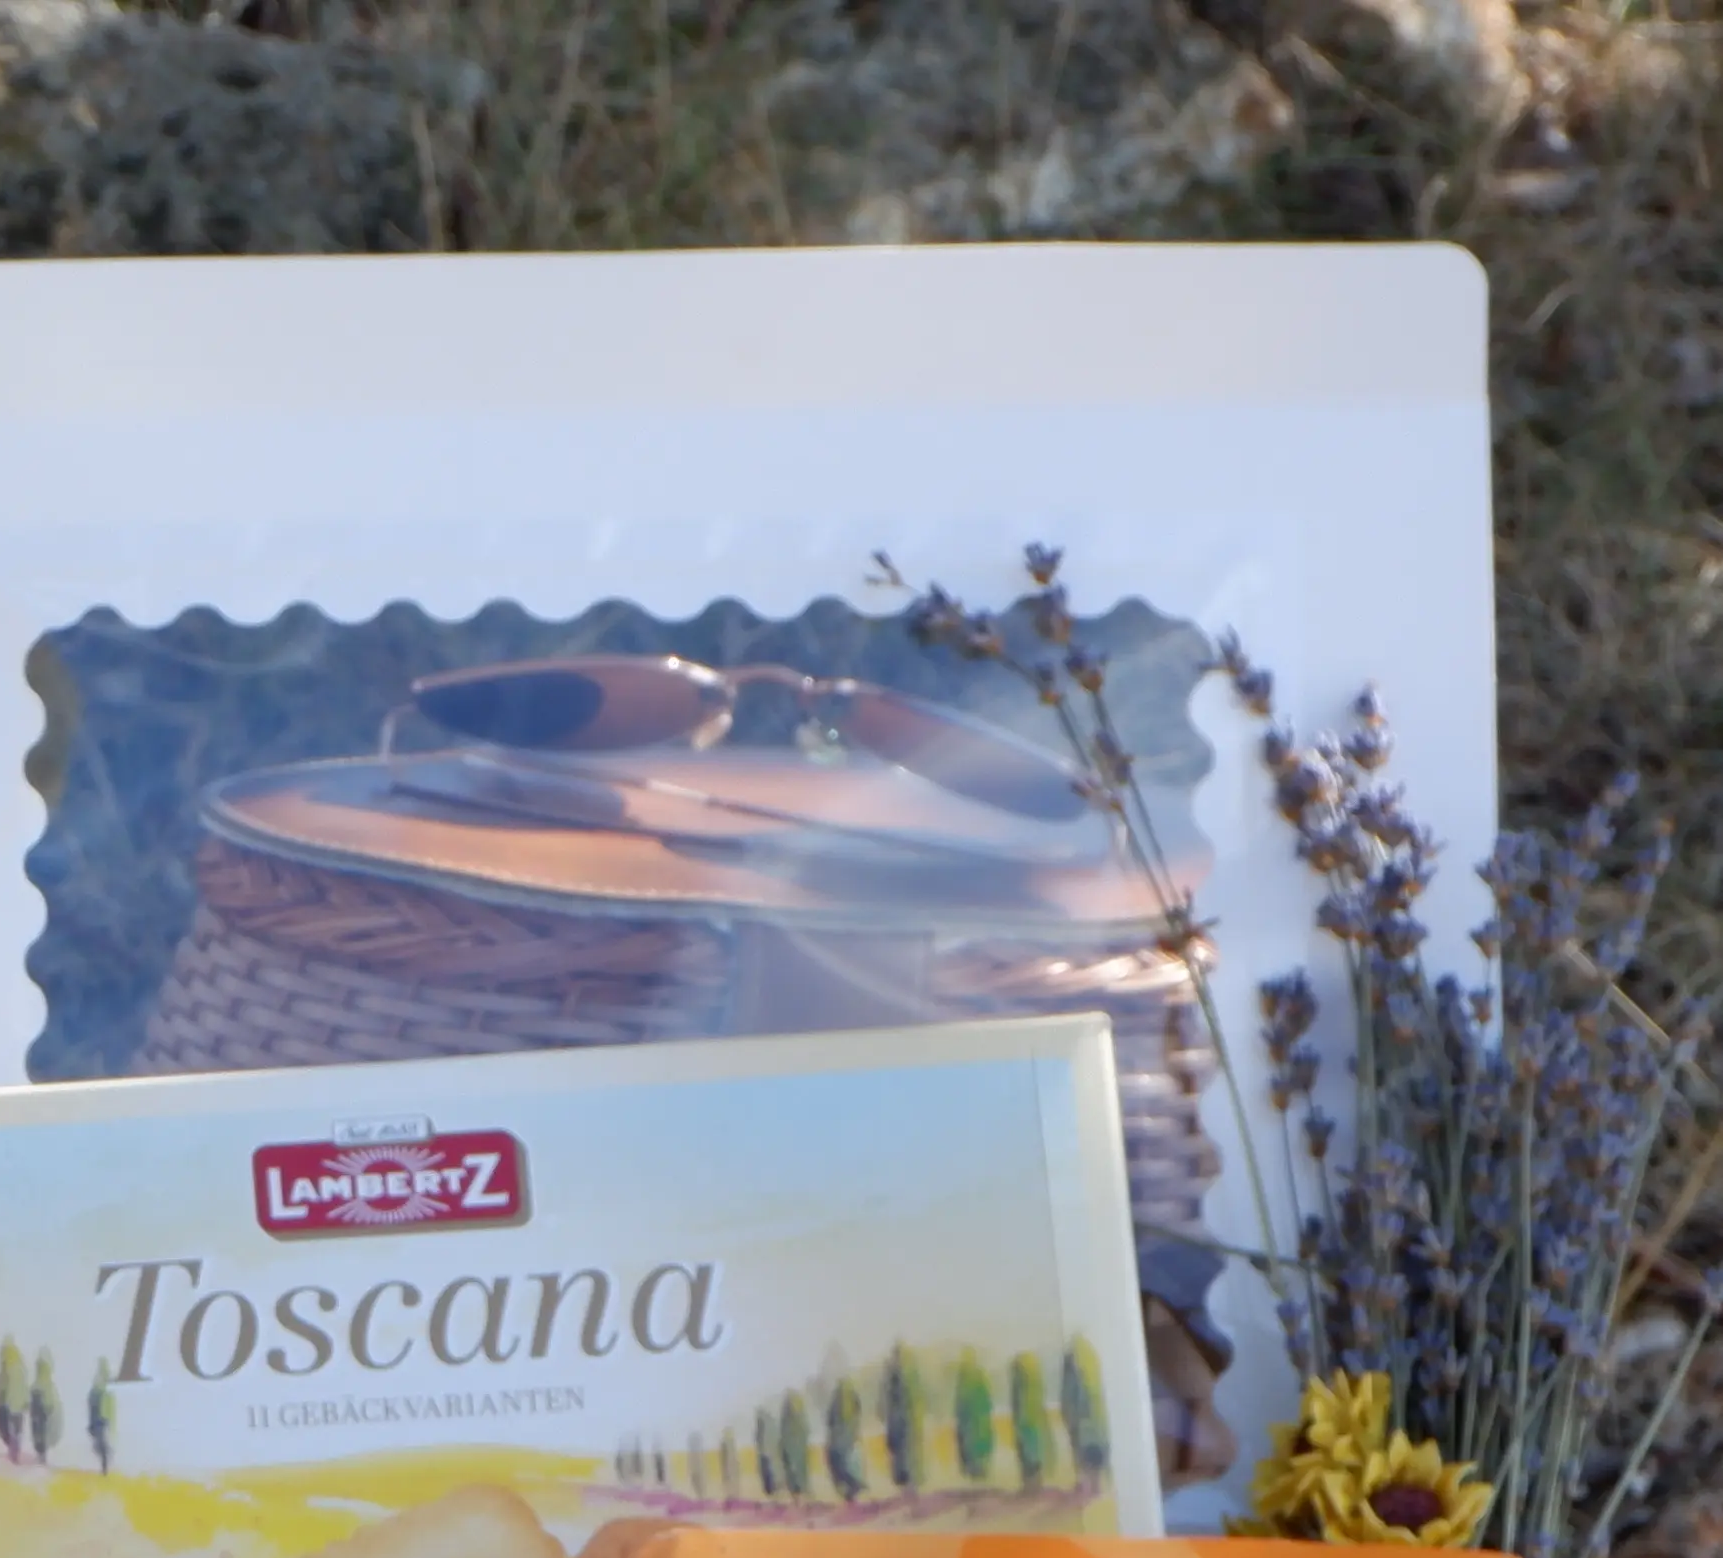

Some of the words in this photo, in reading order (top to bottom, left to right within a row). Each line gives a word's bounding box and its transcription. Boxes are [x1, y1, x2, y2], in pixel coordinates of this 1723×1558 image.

[266, 1152, 510, 1220] LAMBERTZ
[94, 1257, 724, 1385] Toscana
[278, 1386, 586, 1429] GEBÄCKVARIANTEN
